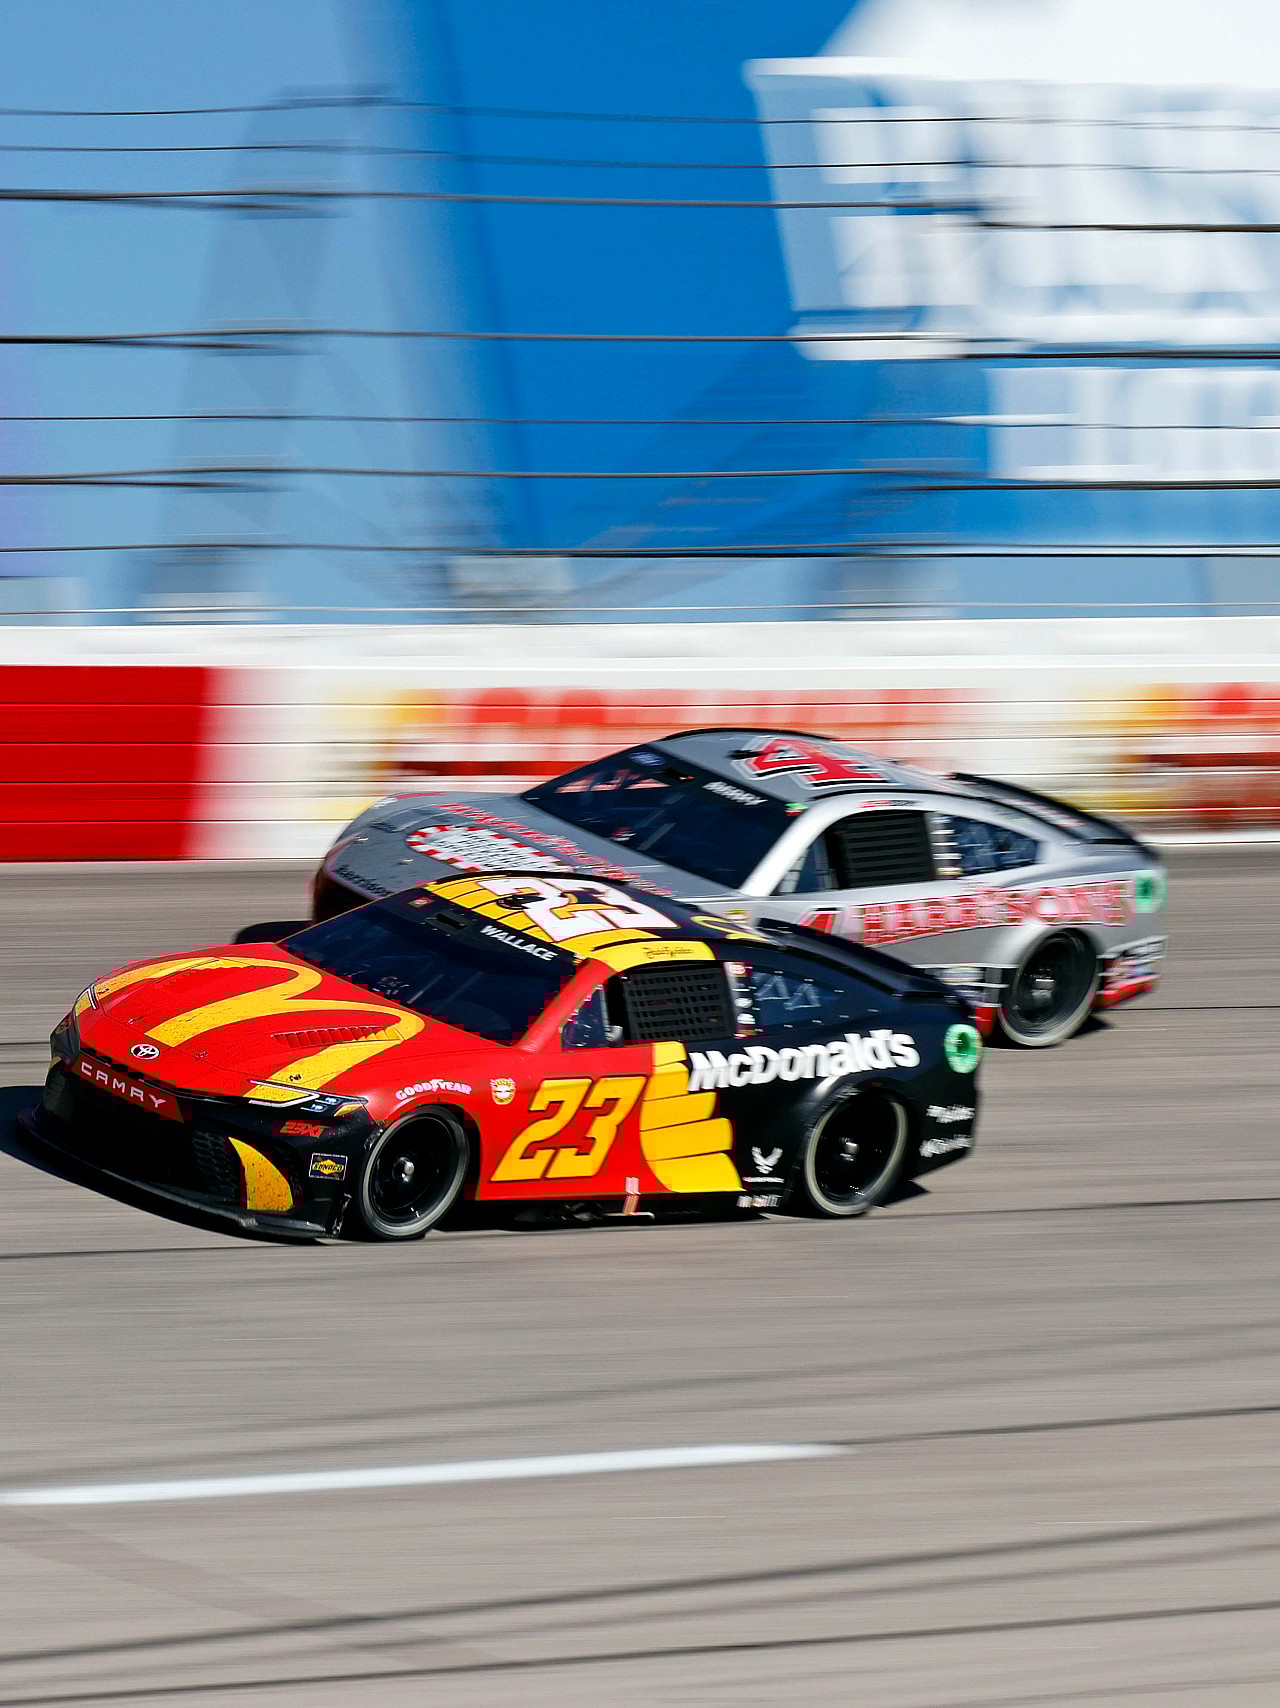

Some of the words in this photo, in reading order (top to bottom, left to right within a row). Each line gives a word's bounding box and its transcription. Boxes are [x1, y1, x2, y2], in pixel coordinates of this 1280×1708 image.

[736, 736, 900, 789] 4
[477, 876, 680, 943] 23
[480, 925, 559, 961] WALLACE
[81, 1062, 167, 1108] CAMRY
[688, 1029, 920, 1092] McDonald's
[395, 1079, 472, 1101] GOODYEAR
[489, 1076, 647, 1183] 23
